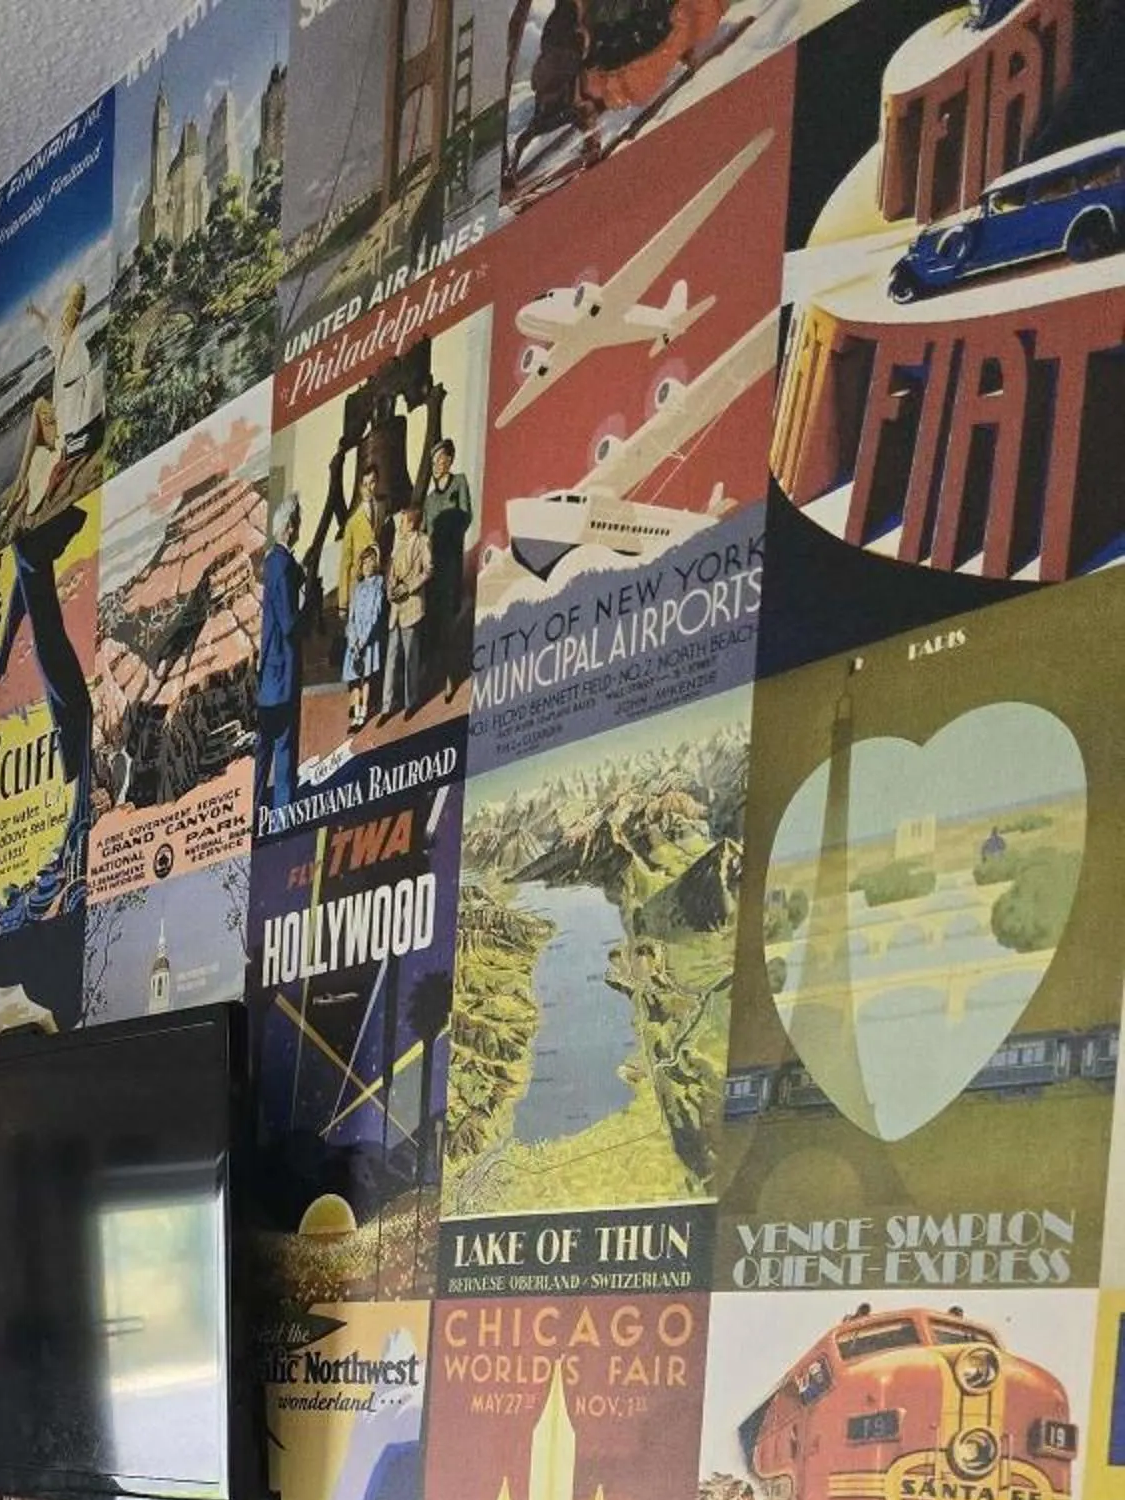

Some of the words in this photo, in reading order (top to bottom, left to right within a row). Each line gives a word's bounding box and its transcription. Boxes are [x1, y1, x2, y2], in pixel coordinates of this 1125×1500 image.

[284, 295, 362, 364] UNITED
[369, 264, 408, 306] AIR
[416, 215, 486, 276] LINES
[287, 267, 473, 408] Philadelphia
[840, 295, 1125, 582] FIAT
[469, 623, 536, 673] CITY
[544, 605, 582, 642] OF
[596, 573, 663, 624] NEW
[676, 533, 766, 591] YORK
[468, 627, 604, 714] MUNICIPAL
[608, 566, 763, 665] AIRPORTS
[907, 627, 966, 661] PARIS
[0, 729, 61, 800] CLIFF
[256, 779, 363, 838] PENNSYLVANIA
[368, 747, 457, 801] RAILROAD
[90, 851, 146, 877] NATIONAL
[186, 814, 246, 844] PARK
[102, 831, 155, 858] GRAND
[165, 801, 235, 837] CANYON
[328, 808, 414, 879] TWA
[262, 873, 436, 988] HOLLYWOOD
[454, 1231, 526, 1267] LAKE
[536, 1227, 581, 1265] OF
[595, 1222, 691, 1263] THUN
[736, 1217, 874, 1255] VENICE
[885, 1208, 1075, 1249] SIMPLON
[590, 1271, 692, 1289] SWITZERLAND
[731, 1249, 1072, 1289] ORIENT-EXPRESS
[444, 1303, 693, 1347] CHICAGO
[304, 1351, 420, 1386] Northwest
[444, 1353, 580, 1386] WORLD'S
[608, 1355, 687, 1387] FAIR
[472, 1393, 503, 1413] MAY
[1048, 1426, 1066, 1449] 19
